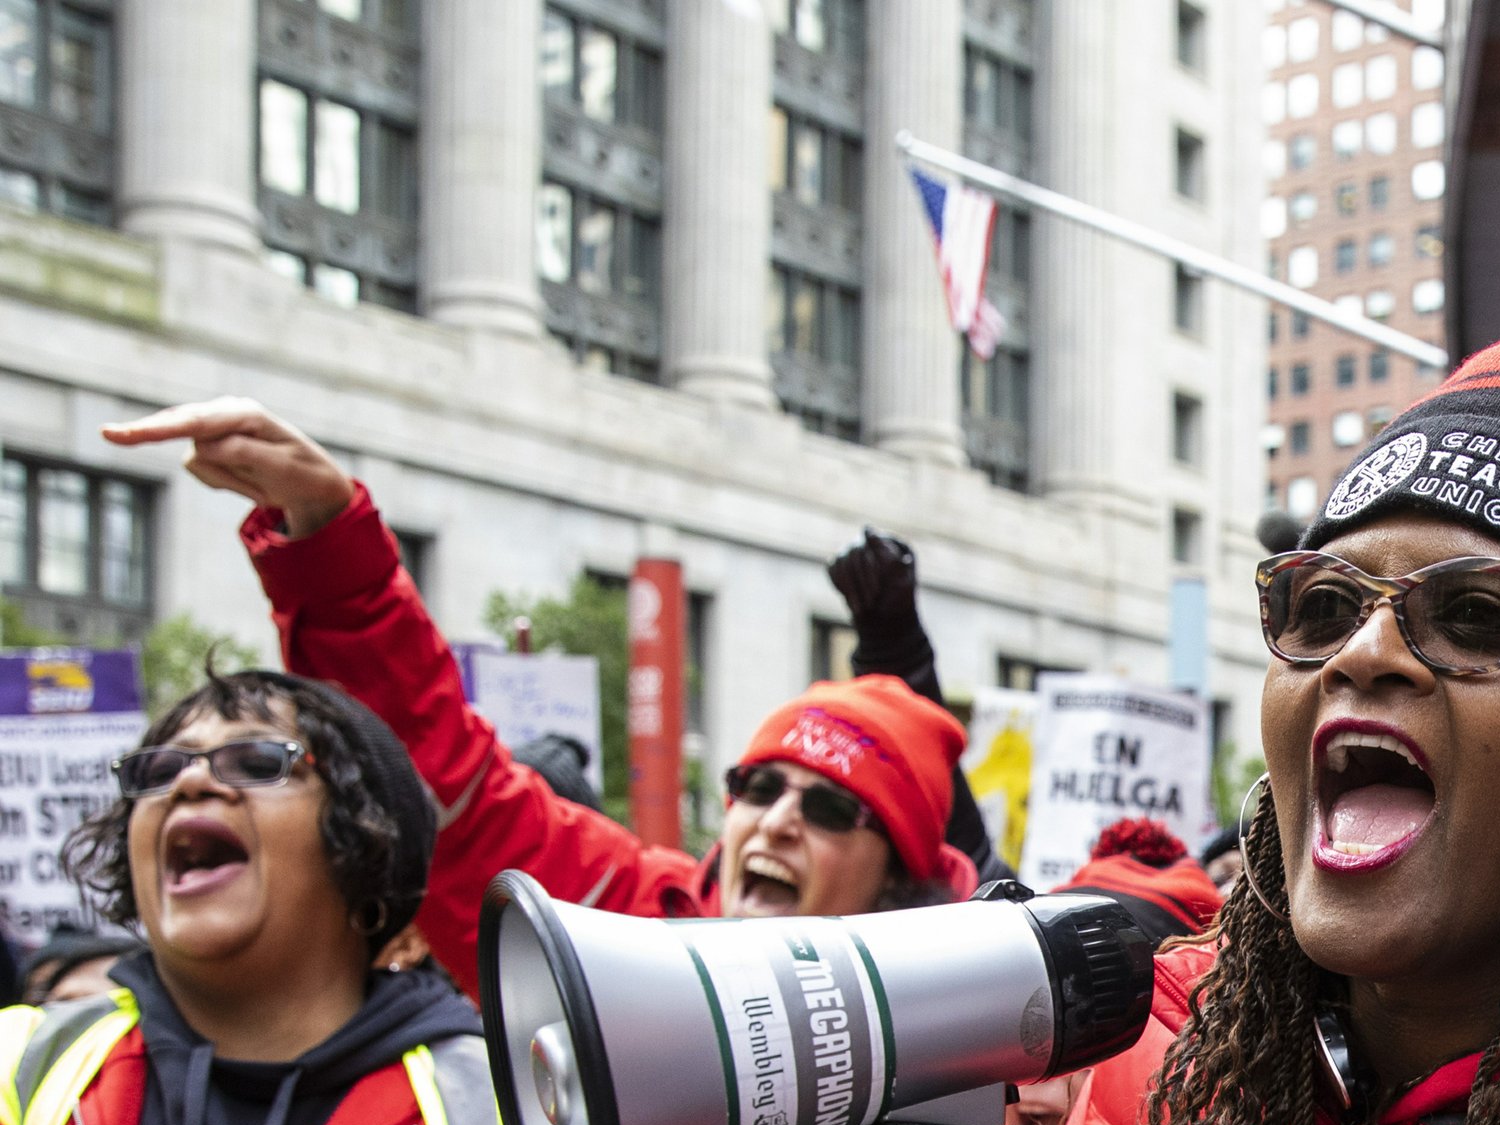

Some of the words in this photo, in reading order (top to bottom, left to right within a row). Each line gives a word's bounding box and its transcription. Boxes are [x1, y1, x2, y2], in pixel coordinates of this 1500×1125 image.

[1095, 731, 1142, 768] EN
[1050, 770, 1183, 815] HUELGA
[742, 996, 784, 1110] Wembley
